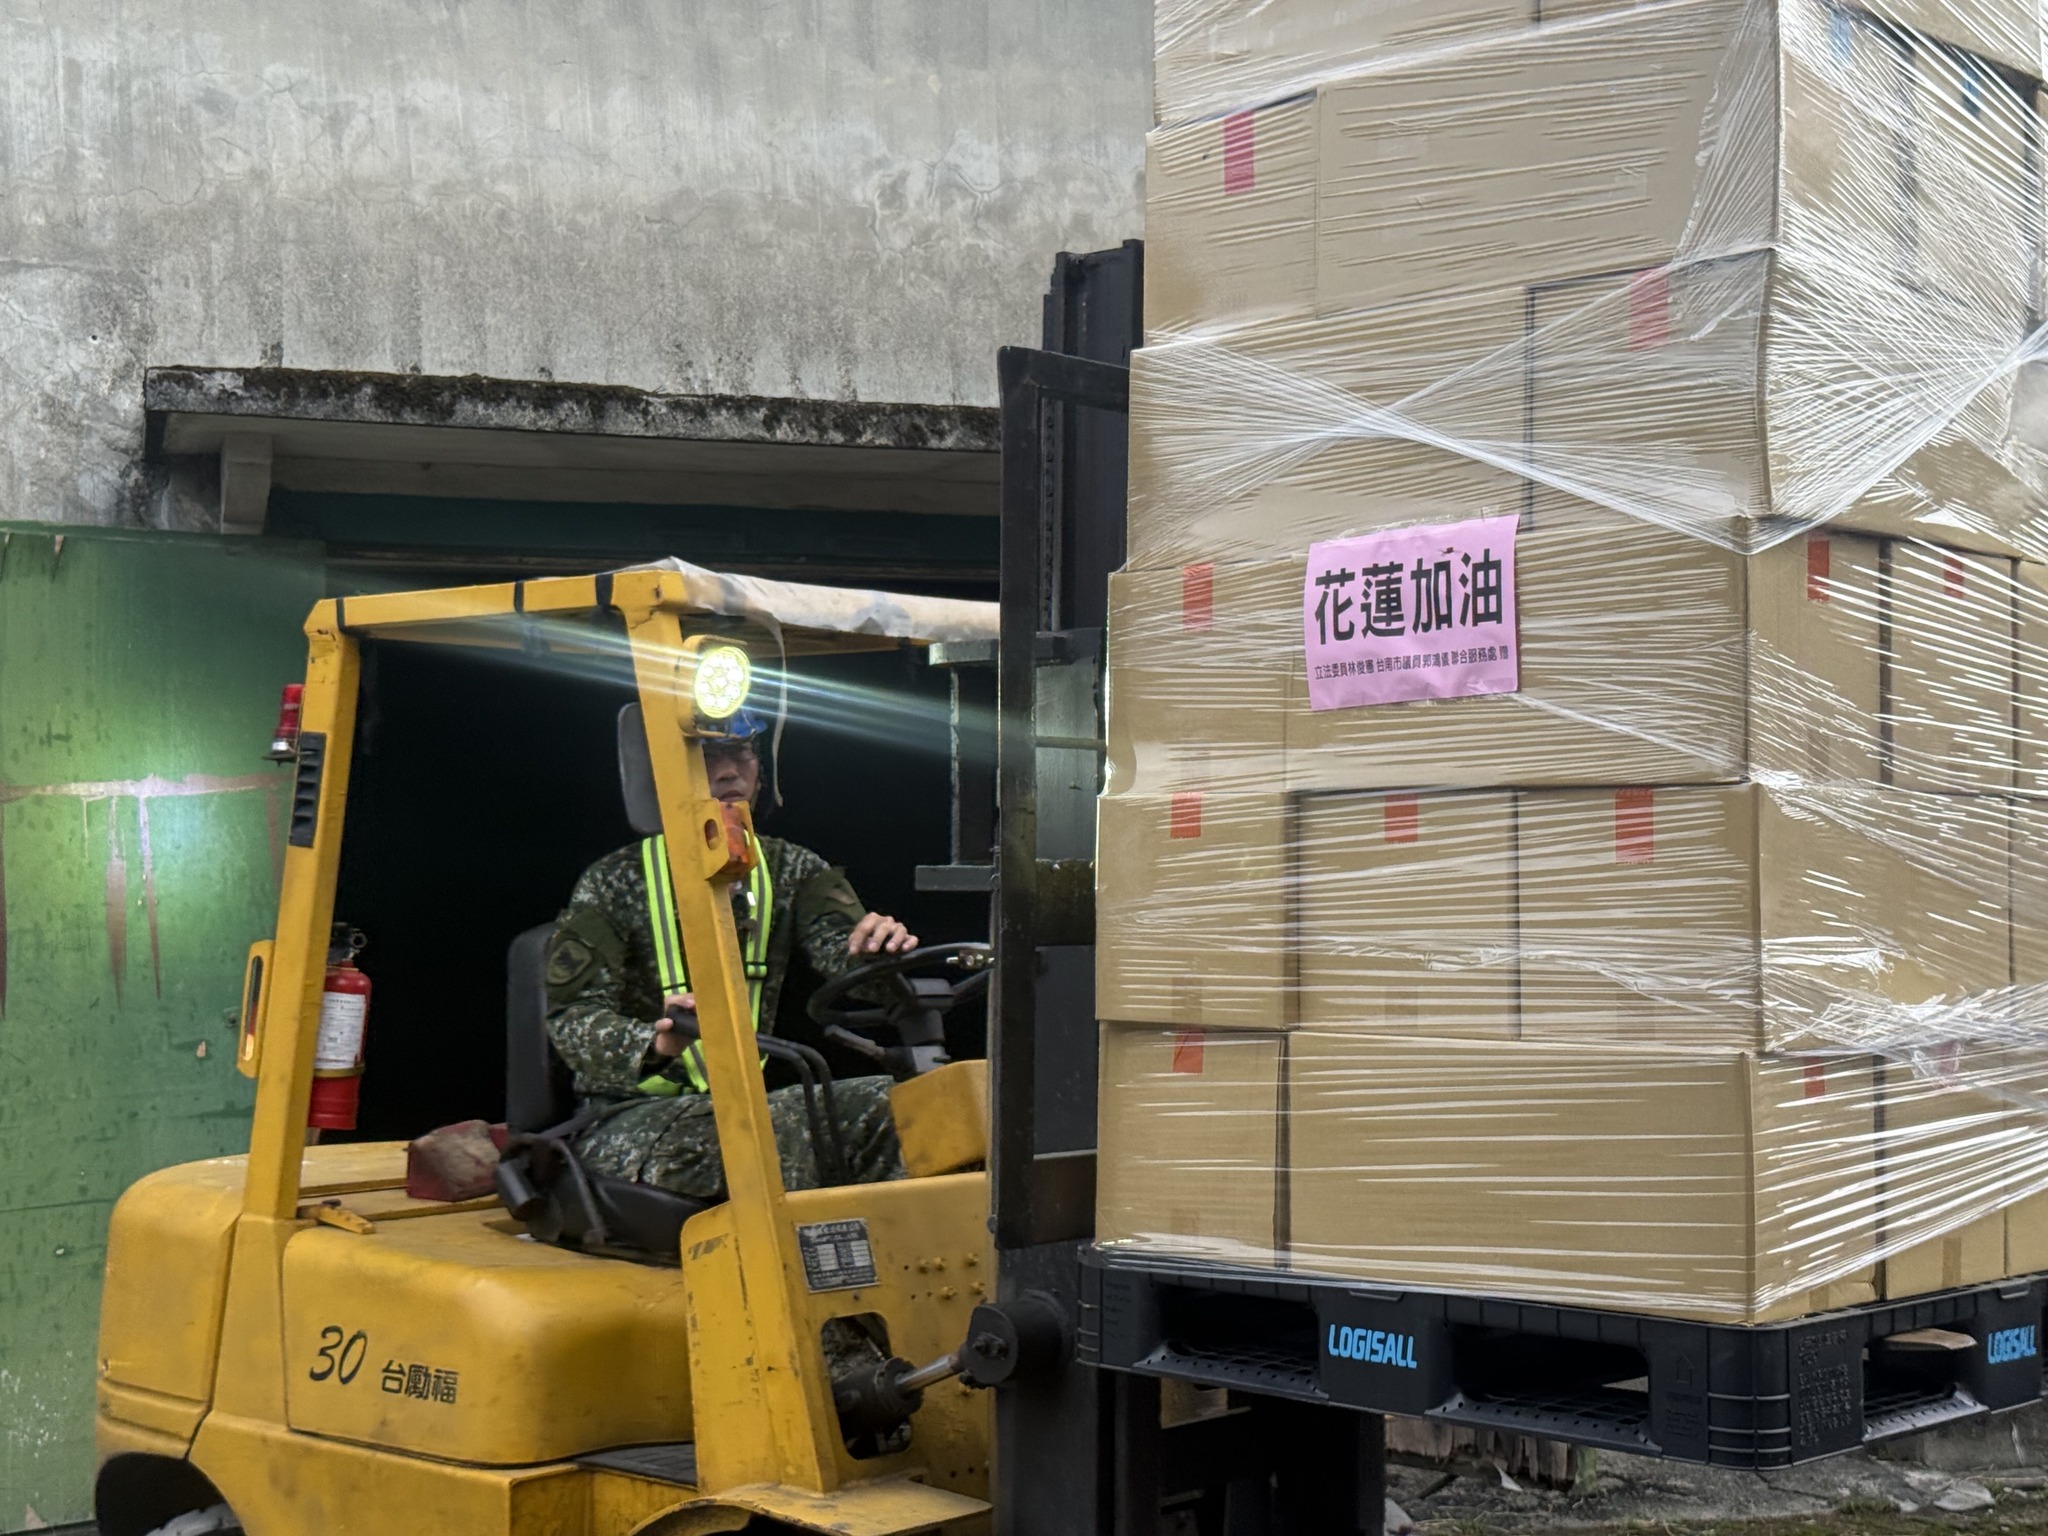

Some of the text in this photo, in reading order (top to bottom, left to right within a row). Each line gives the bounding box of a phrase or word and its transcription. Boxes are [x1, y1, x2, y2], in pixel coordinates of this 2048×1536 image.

[1315, 548, 1503, 645] 花蓮加油
[309, 1325, 459, 1405] 30 台勵福
[1328, 1324, 1418, 1369] LOGISALL
[1988, 1325, 2037, 1364] LOGISALL
